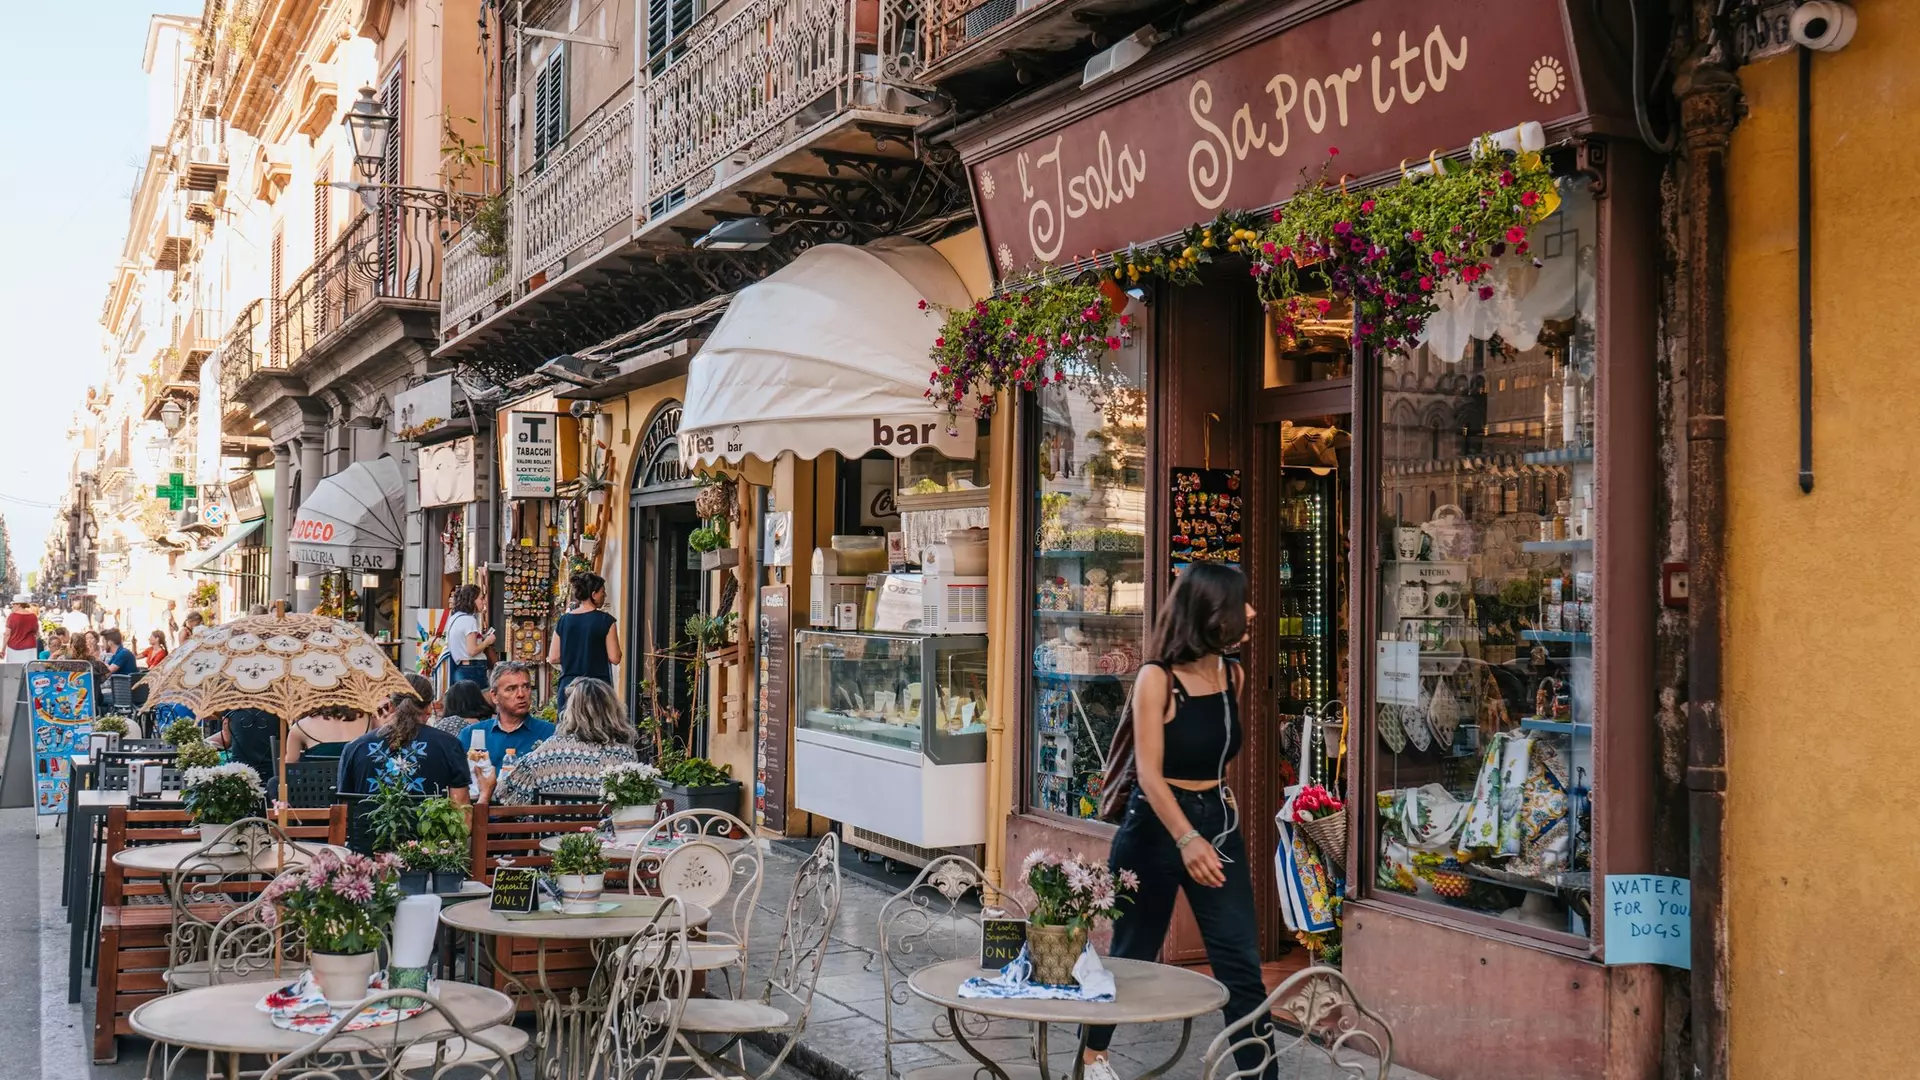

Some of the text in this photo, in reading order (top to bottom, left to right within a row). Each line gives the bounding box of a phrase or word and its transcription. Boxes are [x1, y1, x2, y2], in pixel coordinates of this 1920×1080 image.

[522, 417, 546, 443] T
[873, 418, 937, 446] bar
[517, 447, 552, 456] TABACCHI
[727, 441, 743, 452] bar
[351, 554, 382, 568] BAR
[1419, 568, 1451, 577] KITCHEN
[1612, 877, 1683, 896] WATER
[494, 894, 526, 907] ONLY
[1614, 901, 1642, 916] FOR
[1631, 922, 1681, 939] DOGS
